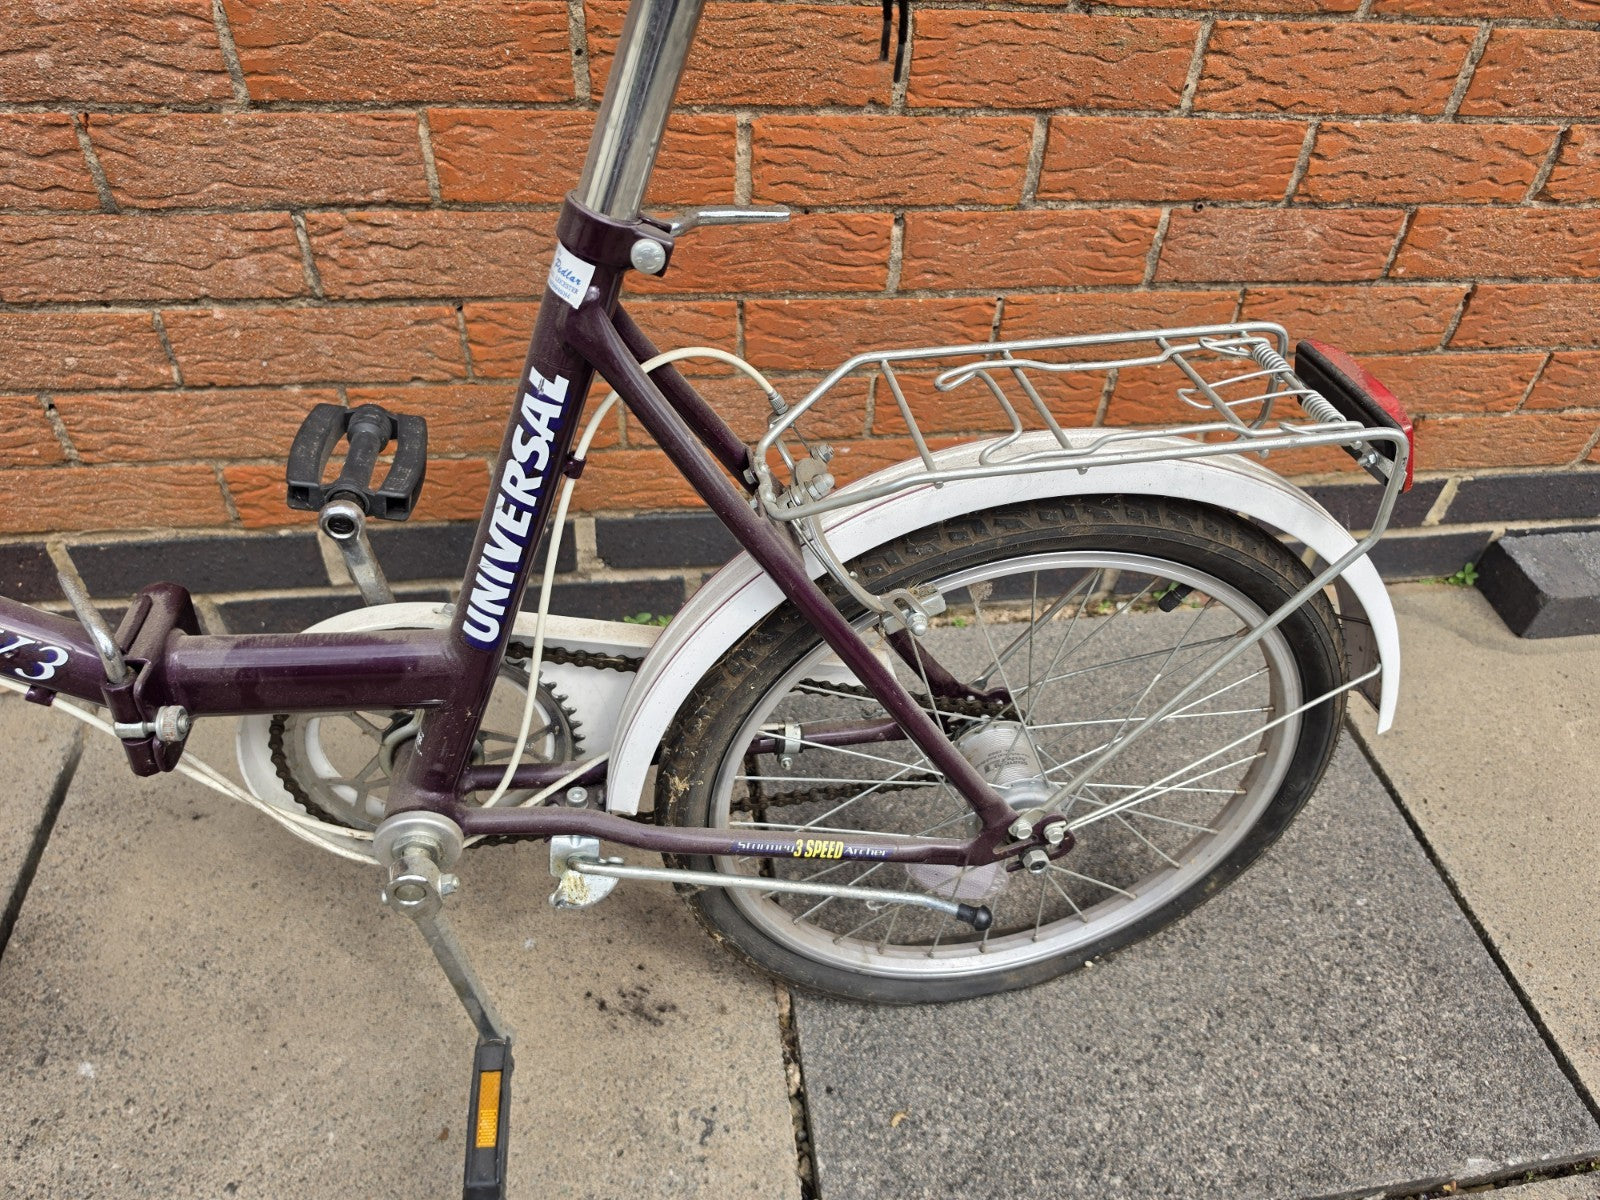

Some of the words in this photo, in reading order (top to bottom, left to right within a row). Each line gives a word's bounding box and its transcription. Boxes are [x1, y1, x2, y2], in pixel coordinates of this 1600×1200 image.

[462, 366, 570, 643] UNIVERSAL
[793, 838, 804, 857] 3
[804, 839, 844, 859] SPEED
[844, 846, 888, 857] Archer
